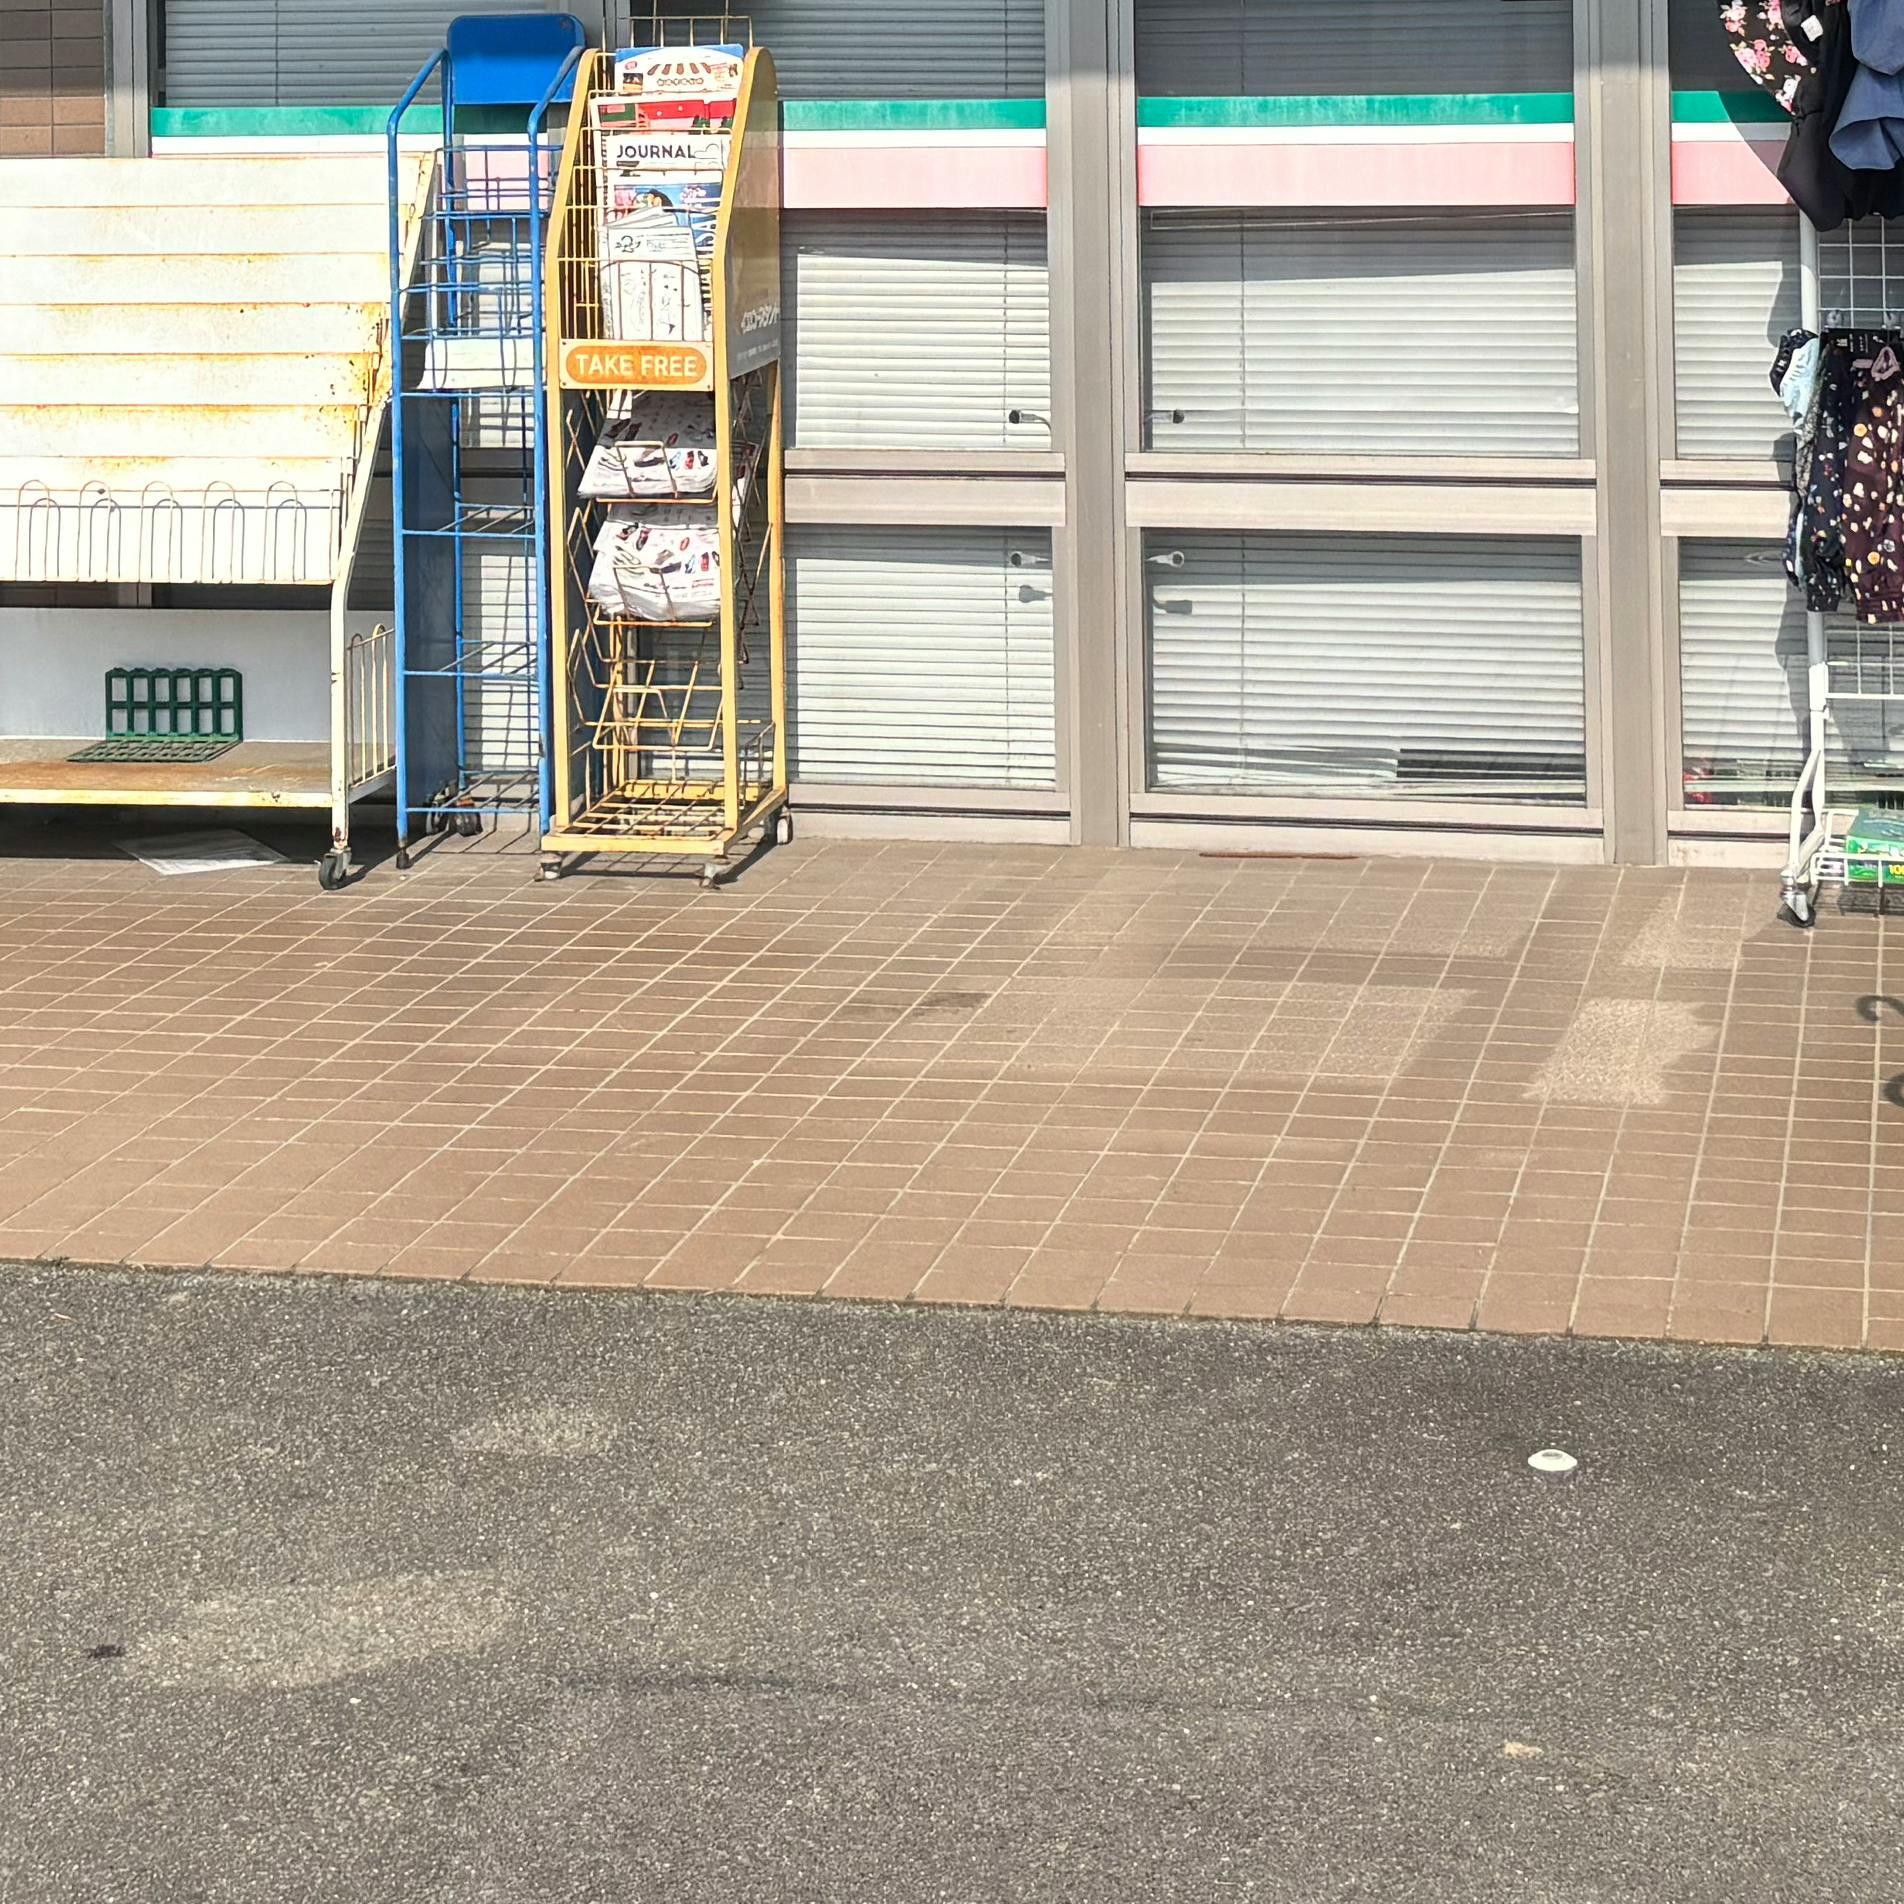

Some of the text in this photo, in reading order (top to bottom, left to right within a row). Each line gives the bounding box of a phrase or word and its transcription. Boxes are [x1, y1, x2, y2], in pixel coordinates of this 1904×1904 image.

[616, 144, 696, 159] JOURNAL
[575, 353, 698, 378] TAKE FREE
